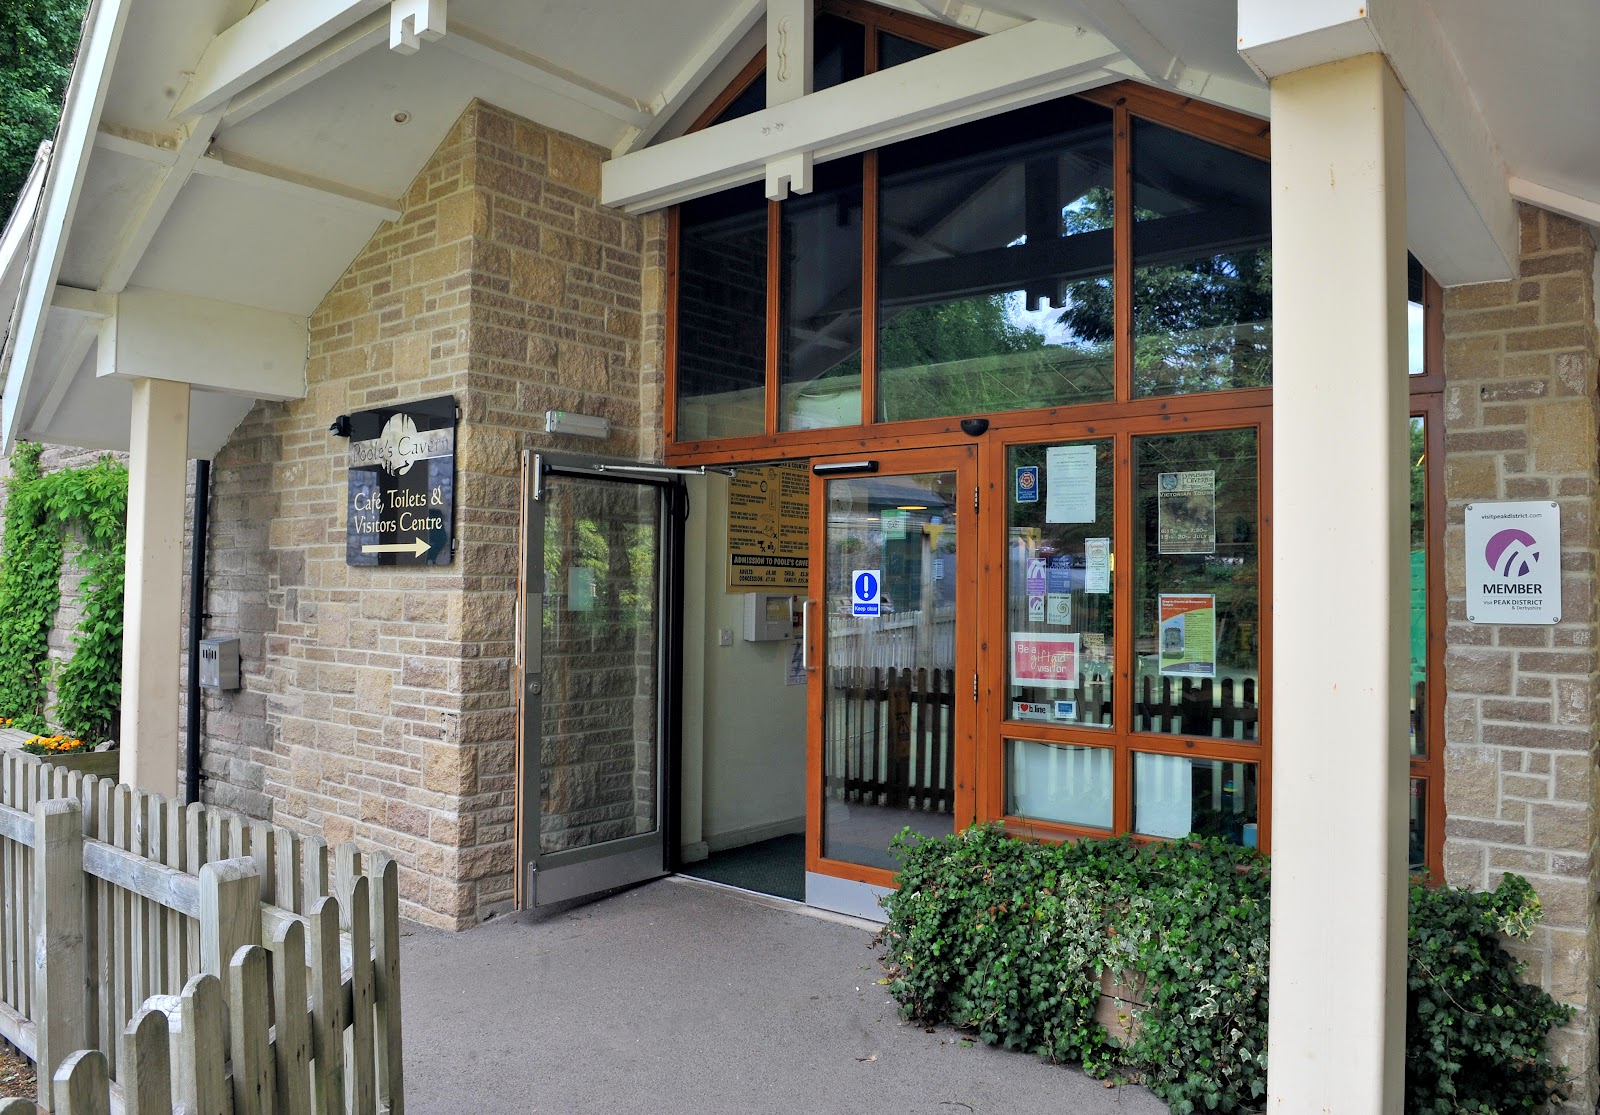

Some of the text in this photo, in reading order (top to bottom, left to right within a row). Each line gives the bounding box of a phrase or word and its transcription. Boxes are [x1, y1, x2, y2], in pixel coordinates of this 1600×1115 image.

[353, 436, 449, 463] Poole's Cavern
[354, 485, 444, 514] Café, Toilets &
[354, 512, 442, 534] Visitors Centre
[733, 556, 765, 564] ADMISSION
[1483, 584, 1542, 594] MEMBER
[1018, 645, 1029, 653] Be
[1037, 664, 1066, 672] visitor
